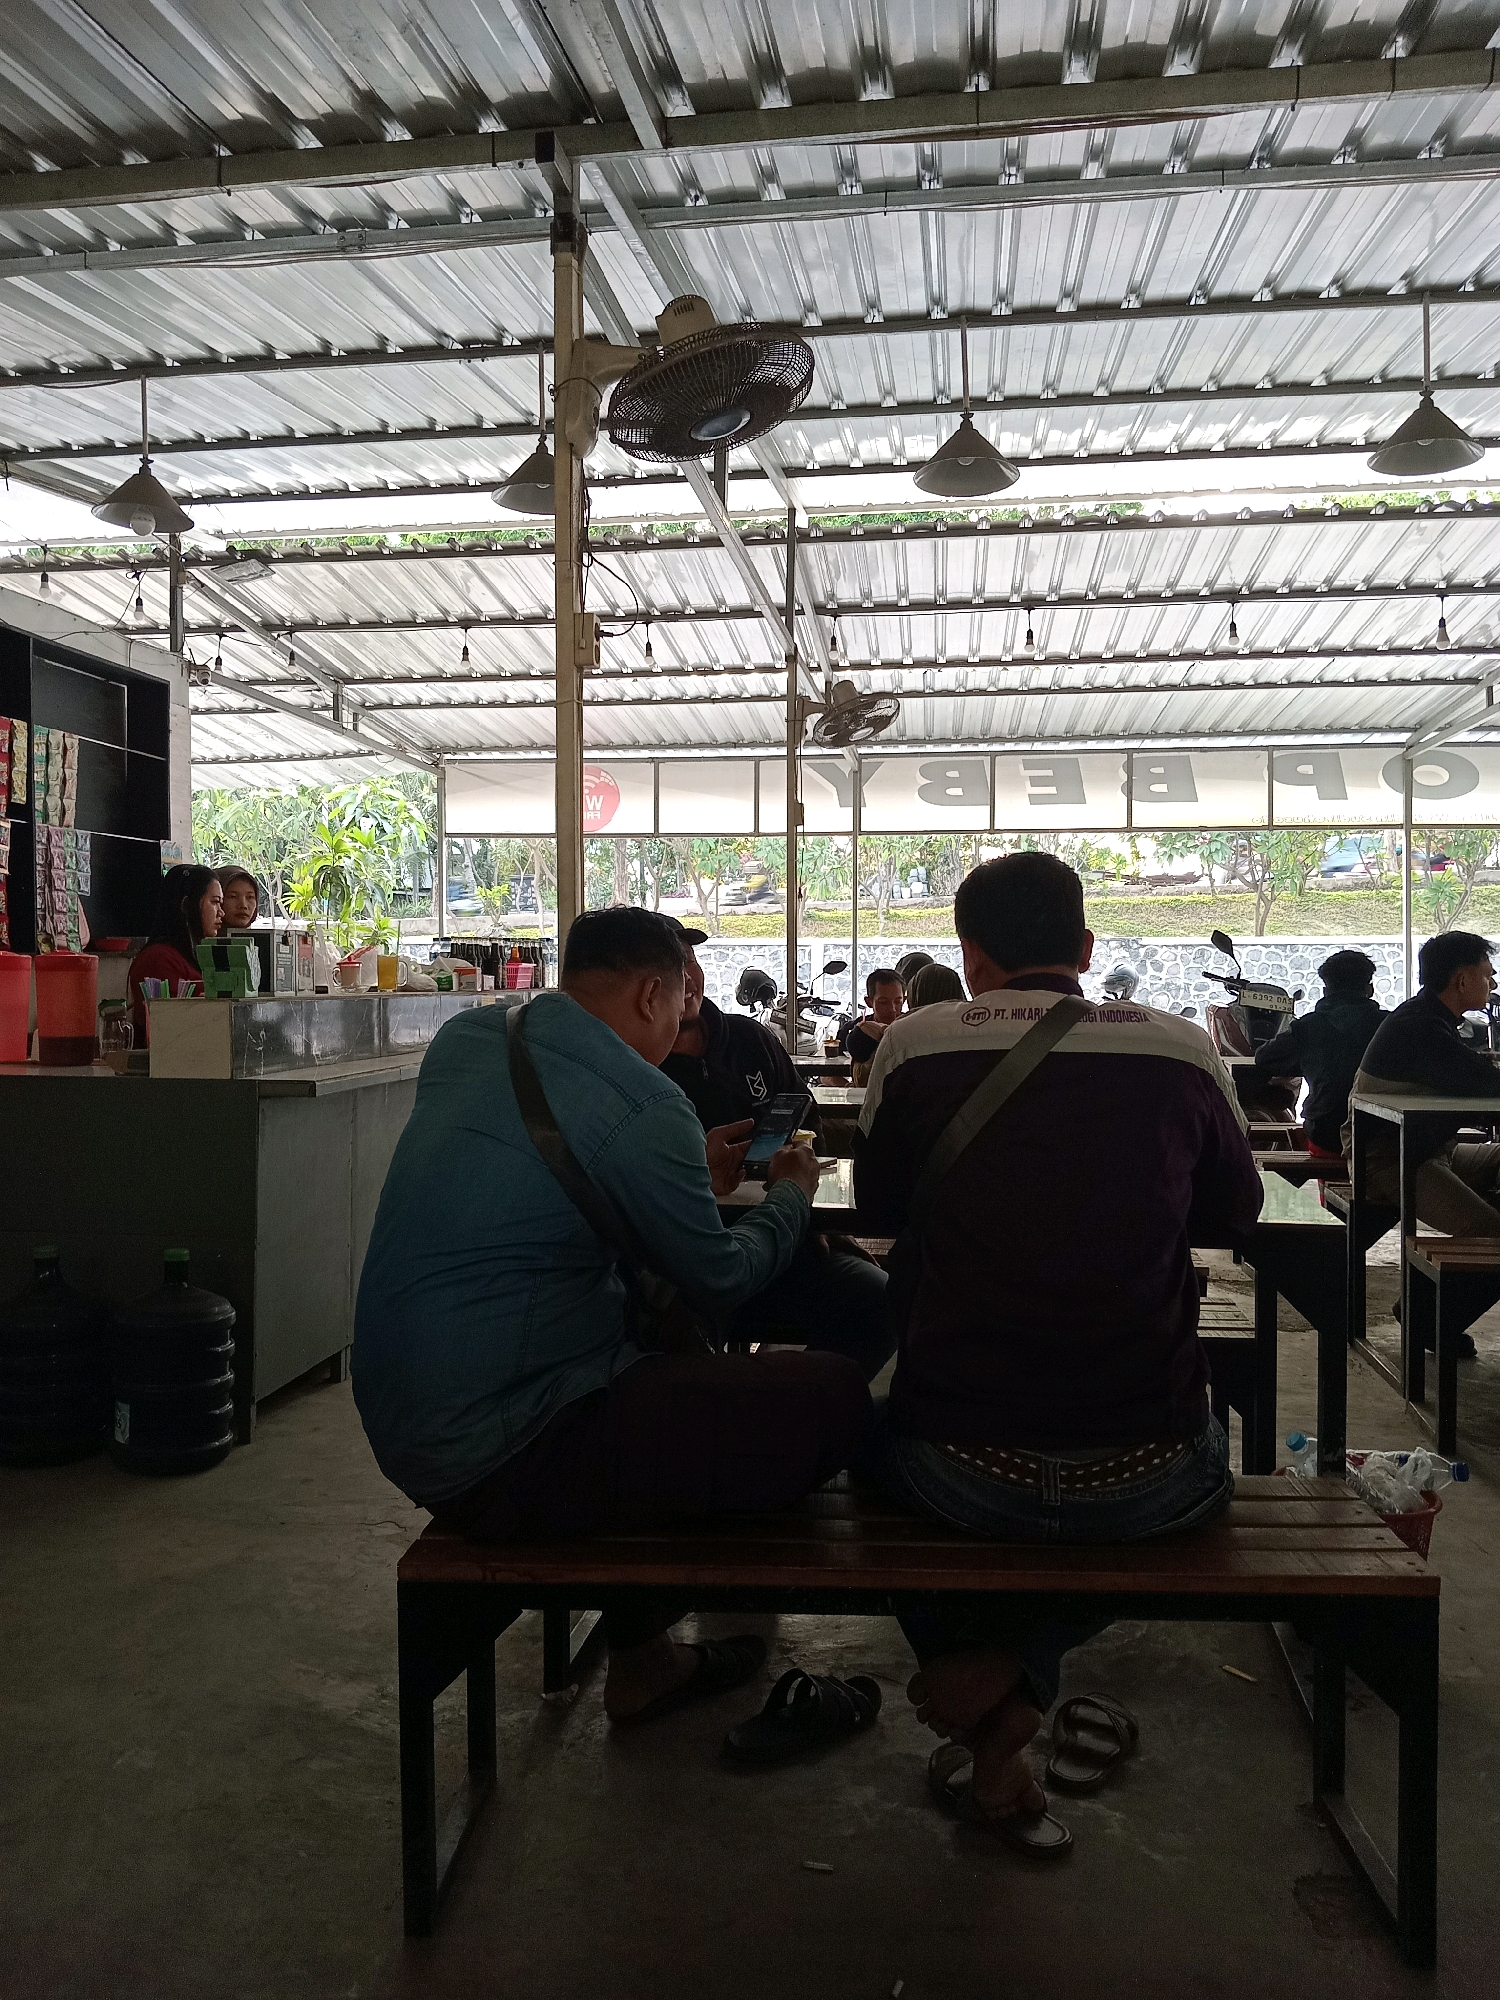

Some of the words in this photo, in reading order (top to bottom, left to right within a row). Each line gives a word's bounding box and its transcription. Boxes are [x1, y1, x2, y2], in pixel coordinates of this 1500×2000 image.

[993, 1008, 1009, 1021] PT.
[1011, 1007, 1044, 1021] HIKARI
[1099, 1009, 1151, 1024] INDONESIA
